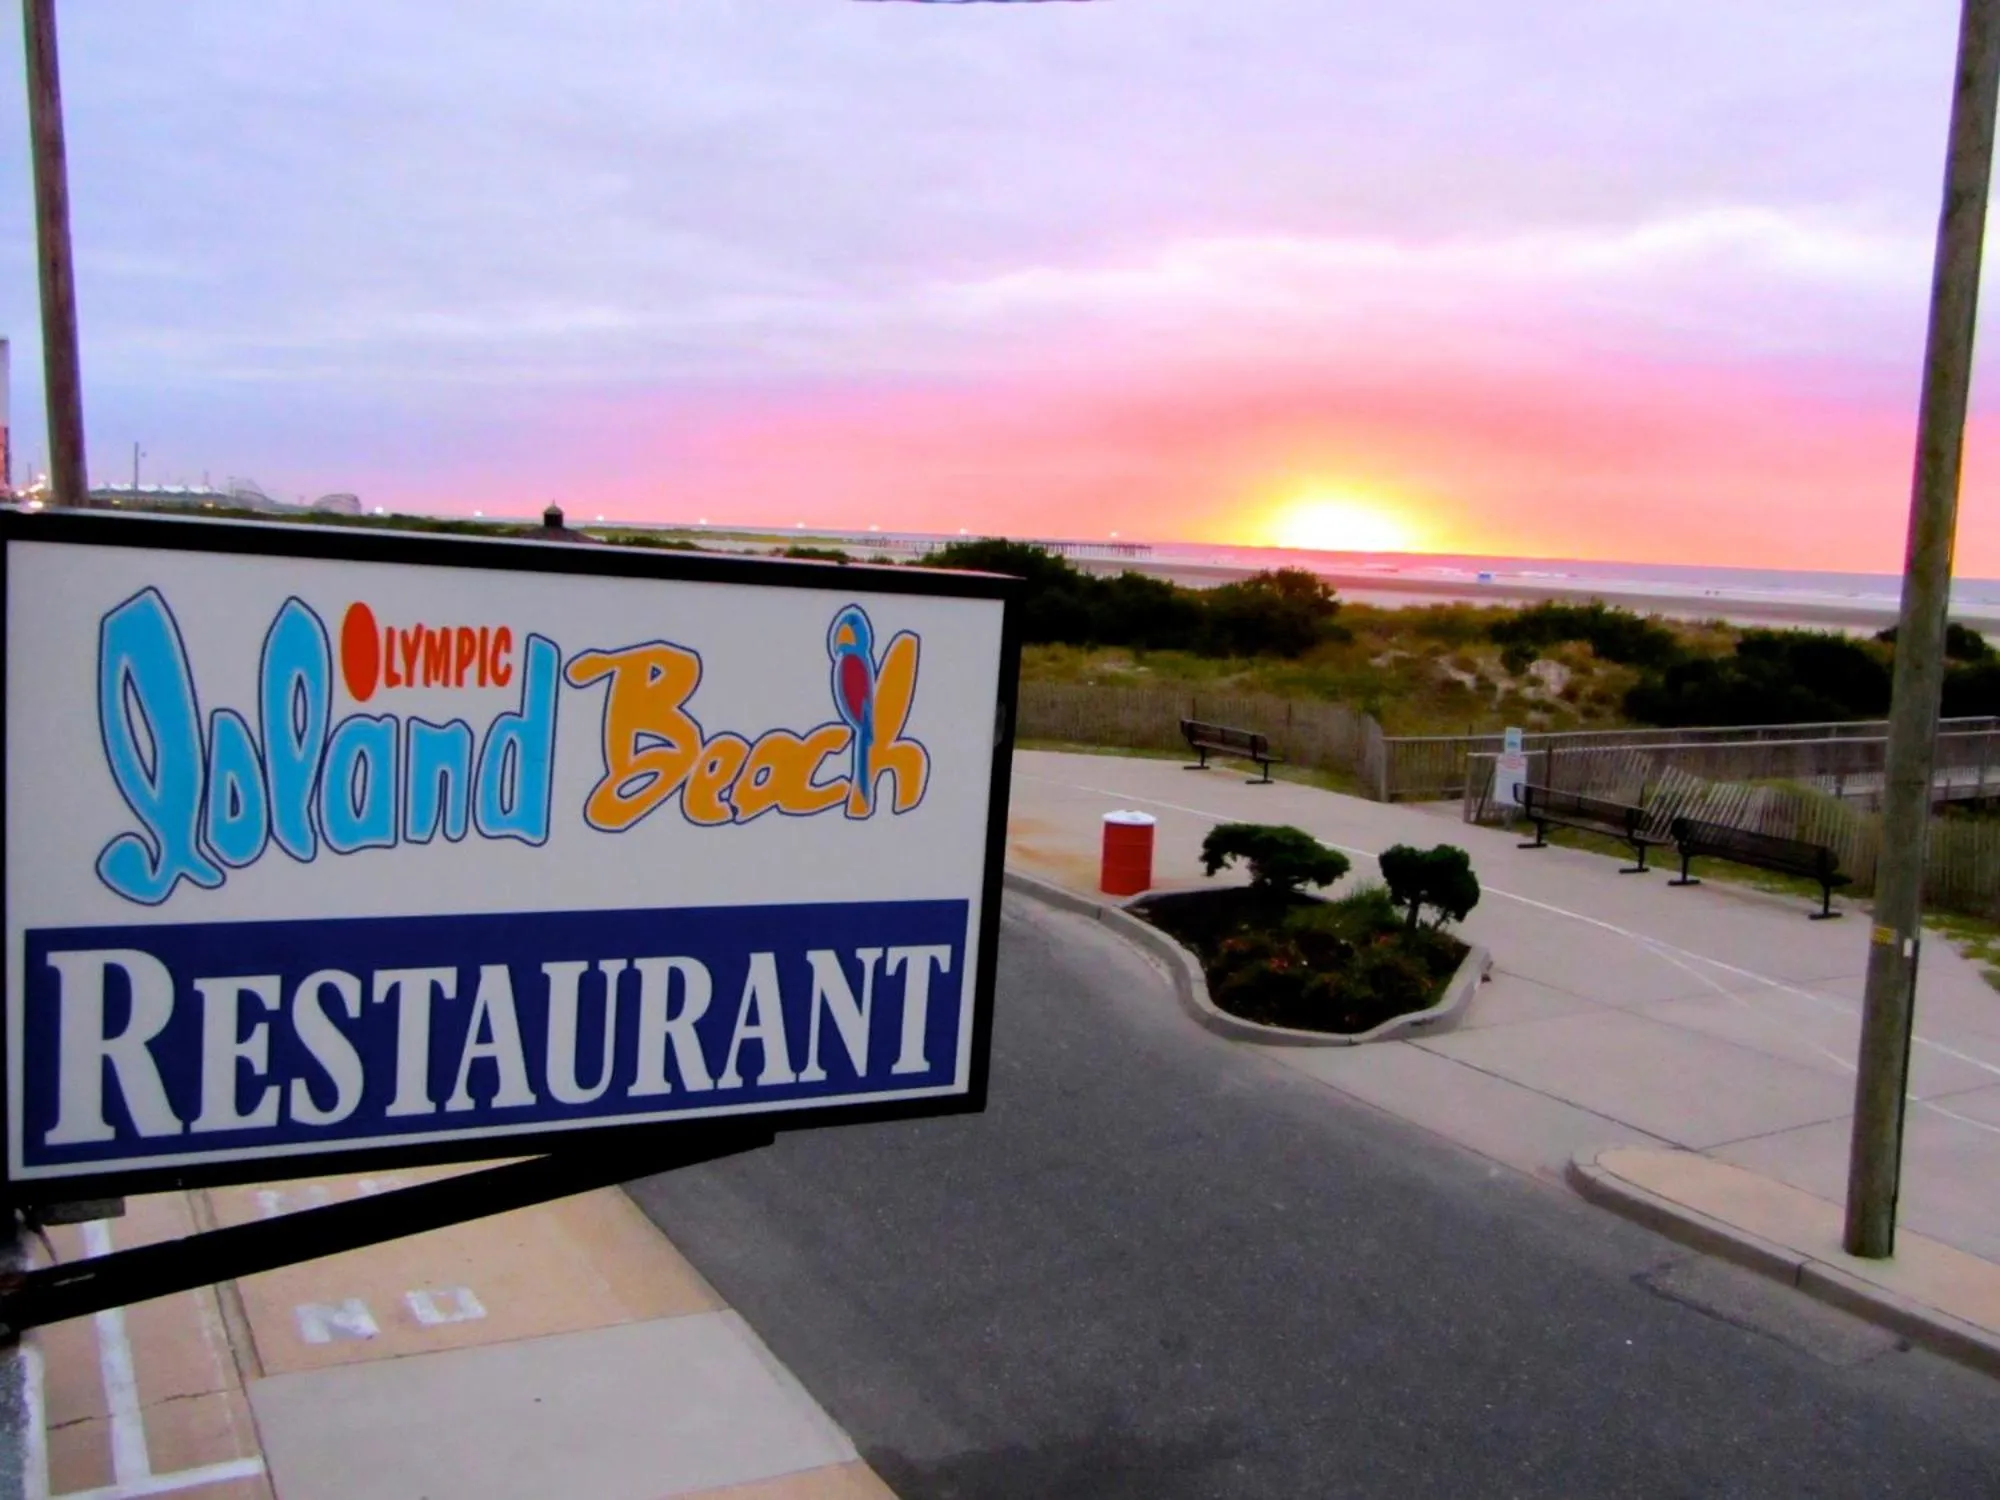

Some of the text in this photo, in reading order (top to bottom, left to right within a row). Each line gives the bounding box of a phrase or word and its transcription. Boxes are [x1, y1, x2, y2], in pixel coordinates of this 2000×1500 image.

[96, 585, 930, 906] Island Beach
[341, 601, 513, 703] OLYMPIC
[43, 943, 952, 1147] RESTAURANT
